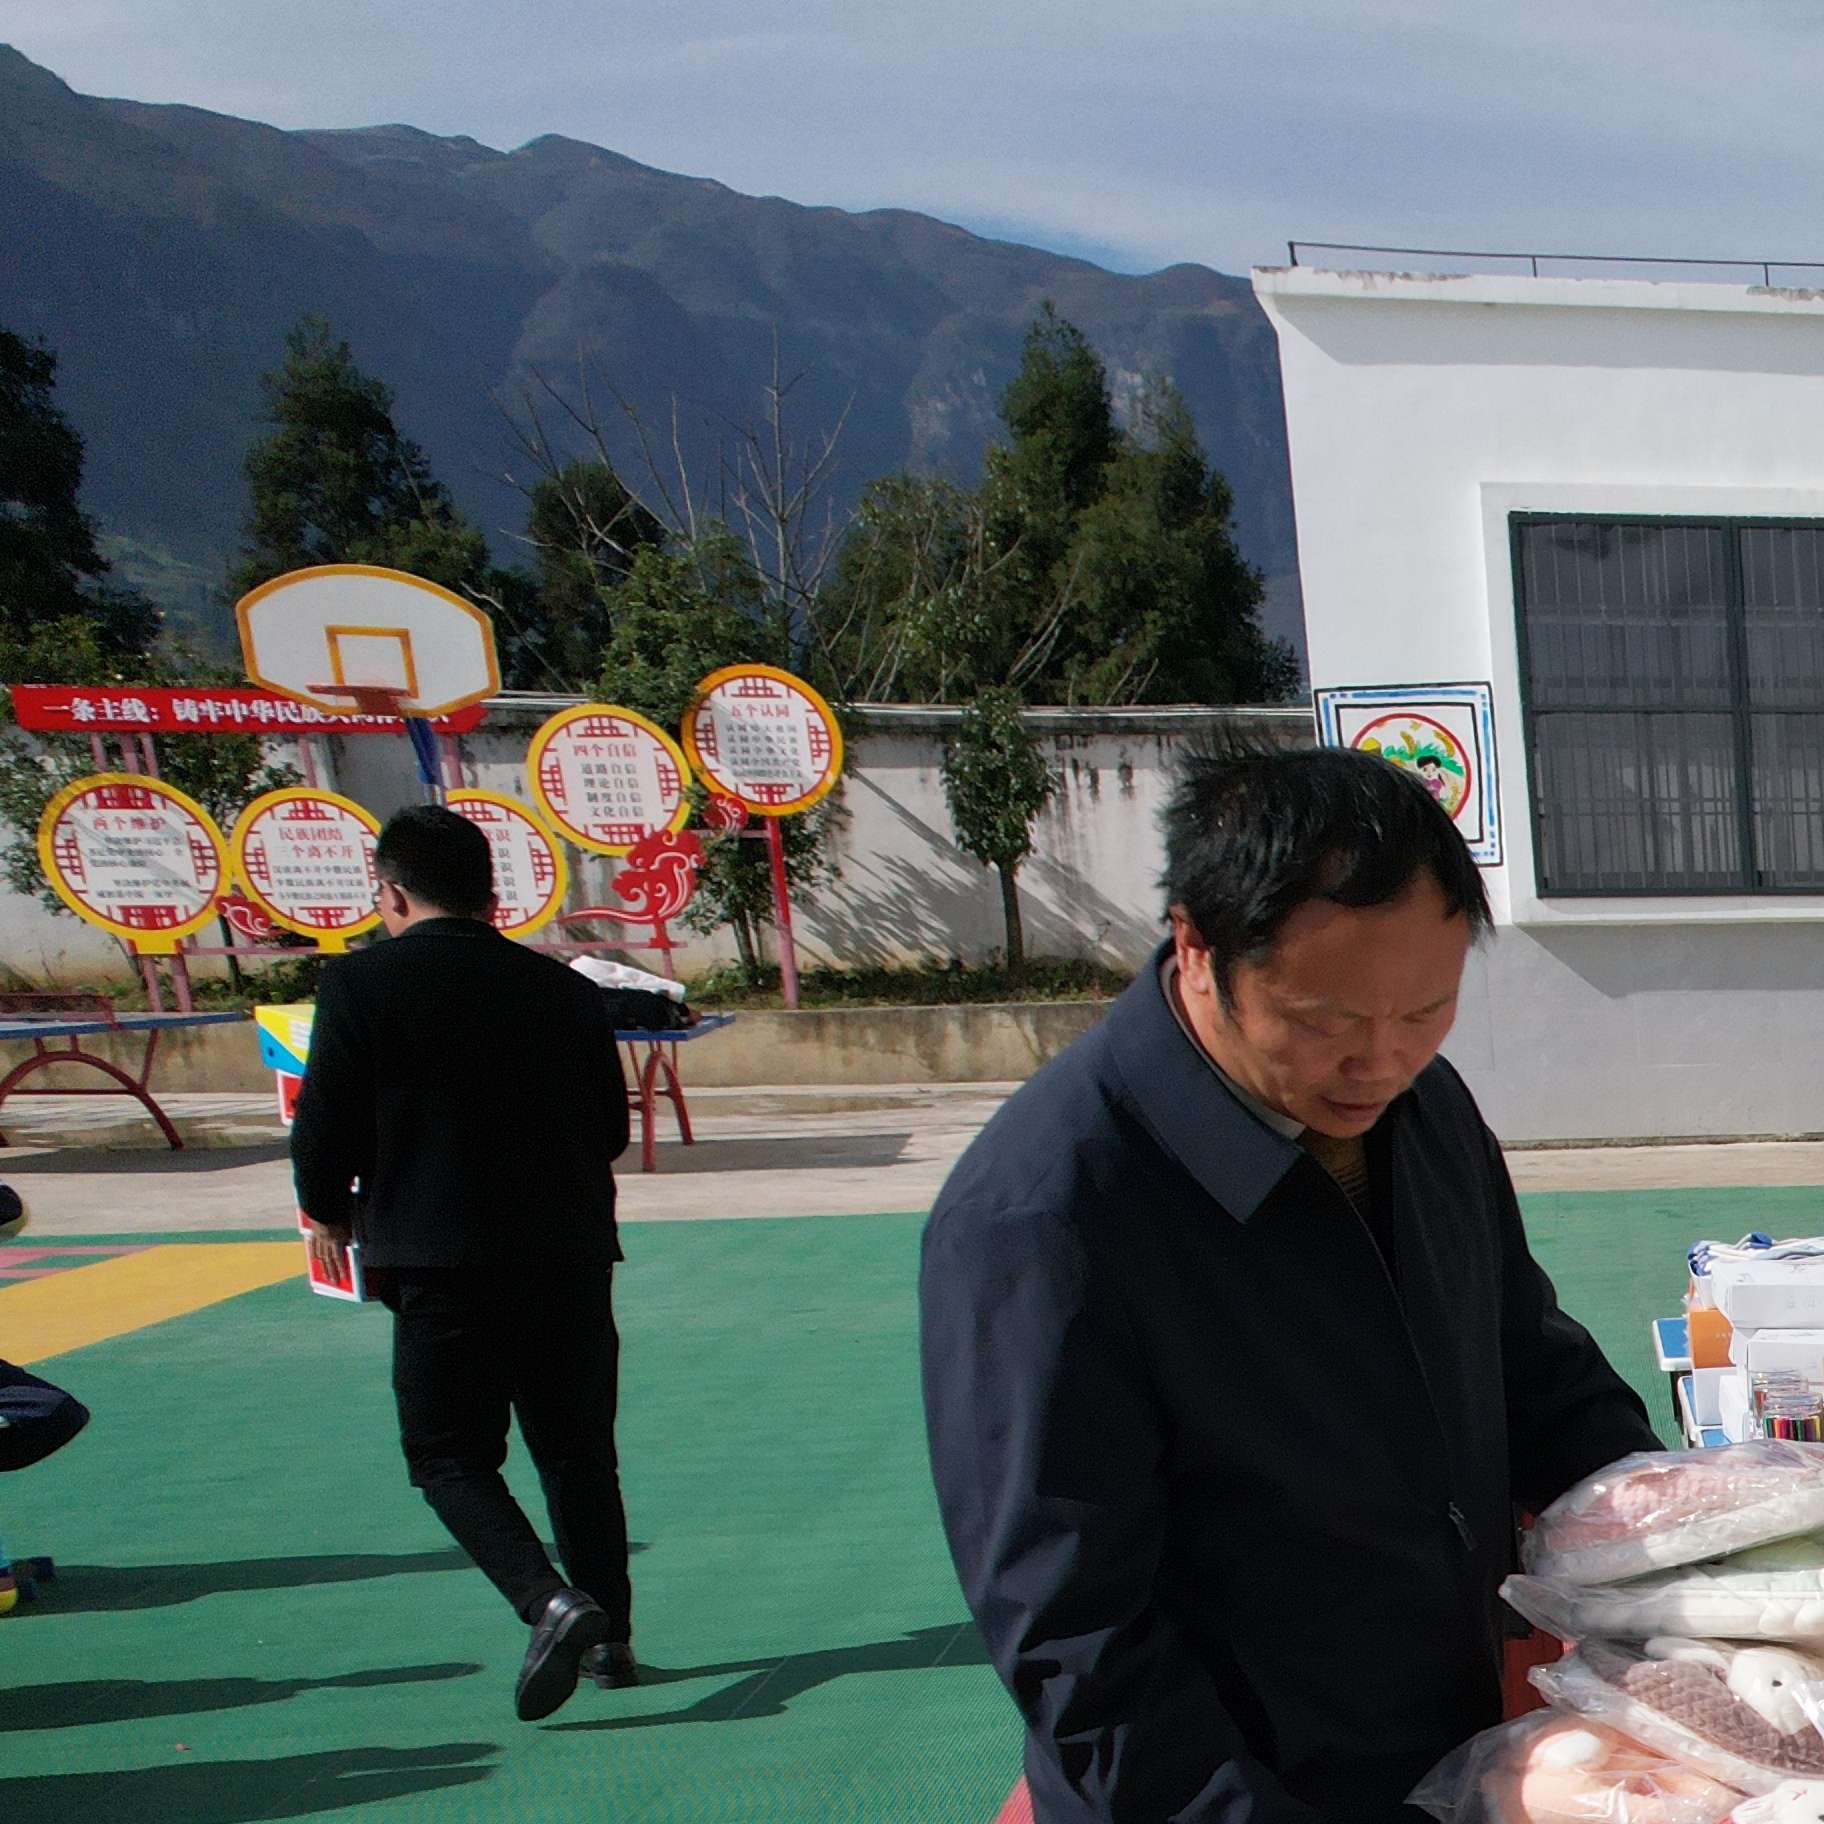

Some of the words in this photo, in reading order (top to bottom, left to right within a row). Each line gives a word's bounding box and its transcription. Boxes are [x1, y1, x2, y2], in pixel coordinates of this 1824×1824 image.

[574, 744, 637, 757] 四个自信
[93, 816, 166, 831] 两个维护
[278, 827, 343, 841] 民族团结
